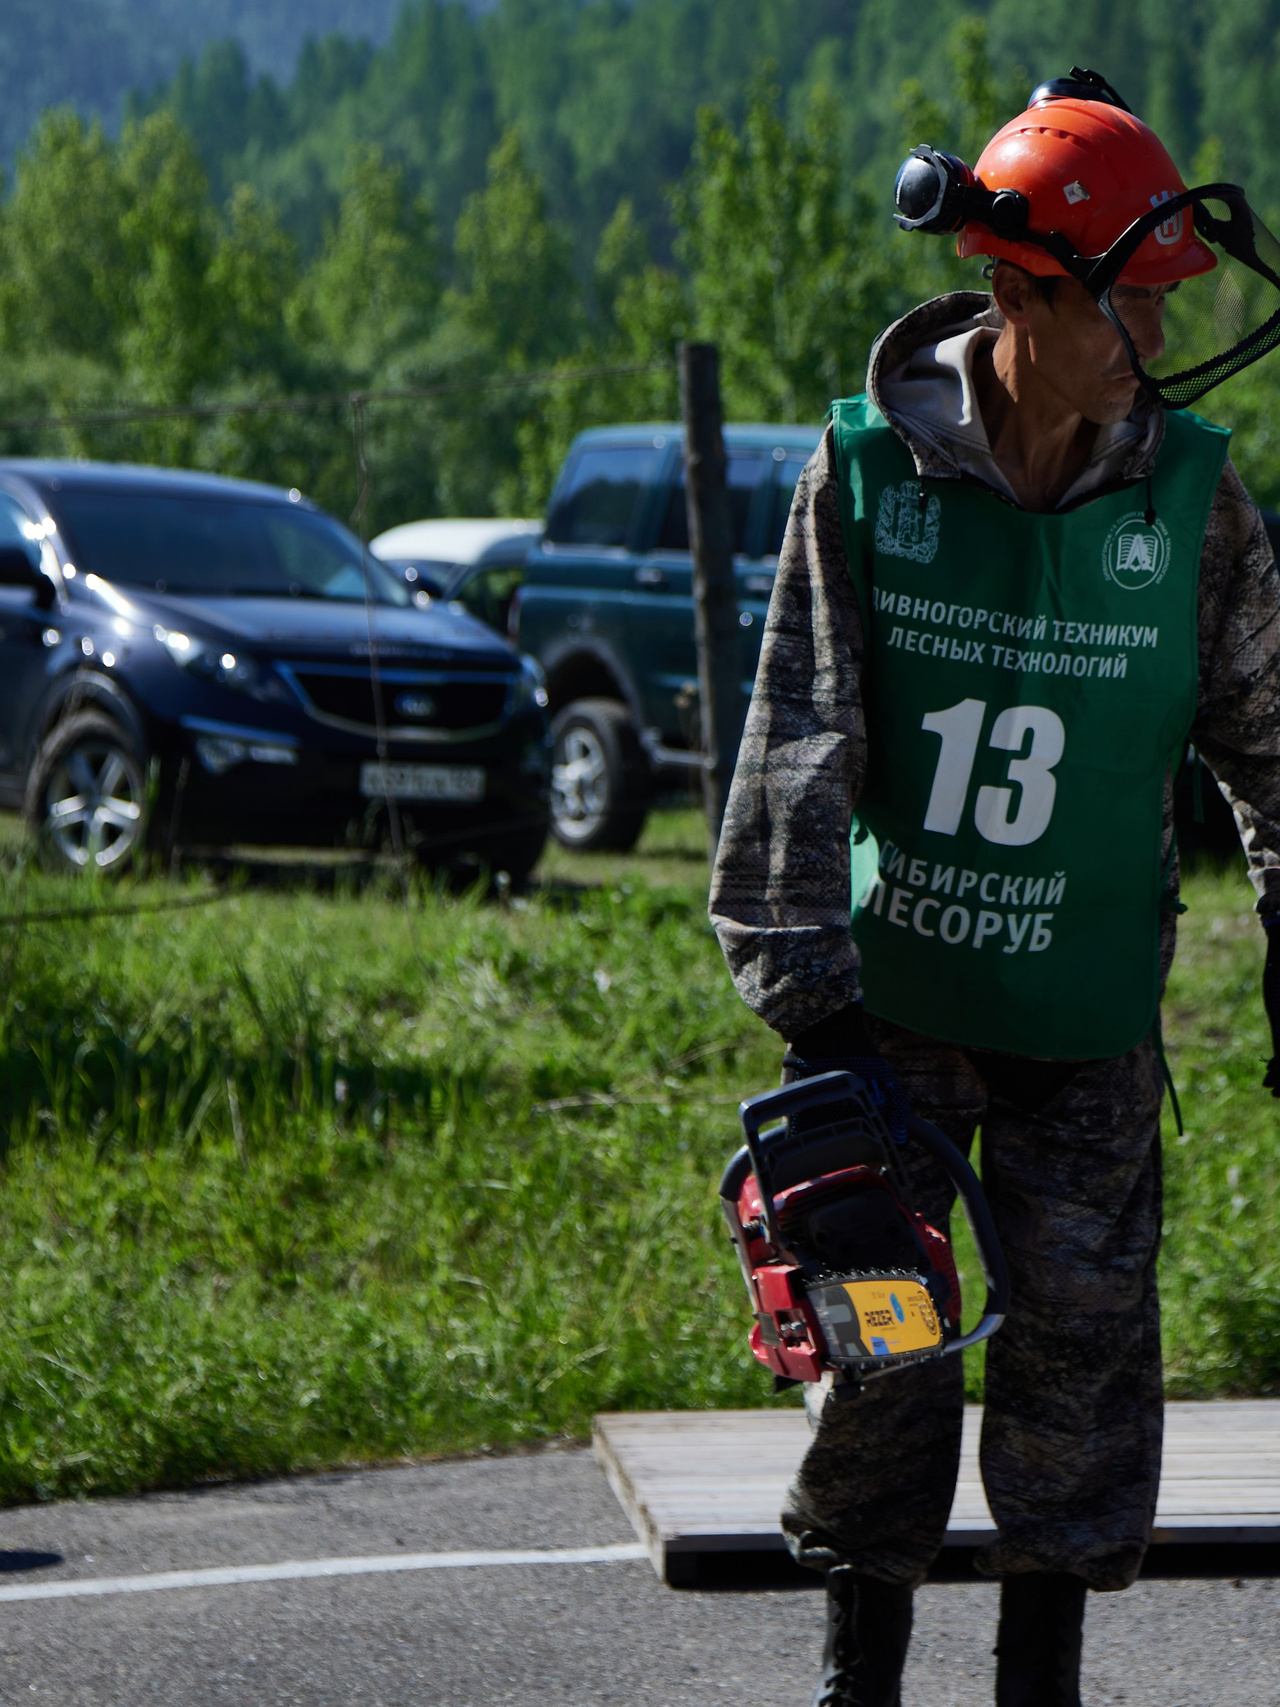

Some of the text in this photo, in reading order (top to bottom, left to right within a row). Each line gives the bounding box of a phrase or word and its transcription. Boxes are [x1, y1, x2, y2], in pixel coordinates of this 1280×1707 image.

[887, 626, 1129, 679] ЛЕСНЫХ ТЕХНОЛОГИЙ
[1052, 619, 1159, 649] ТЕХНИКУМ
[920, 698, 1066, 847] 13
[879, 840, 1067, 907] СИБИРСКИЙ
[858, 874, 1055, 955] ЛЕСОРУБ
